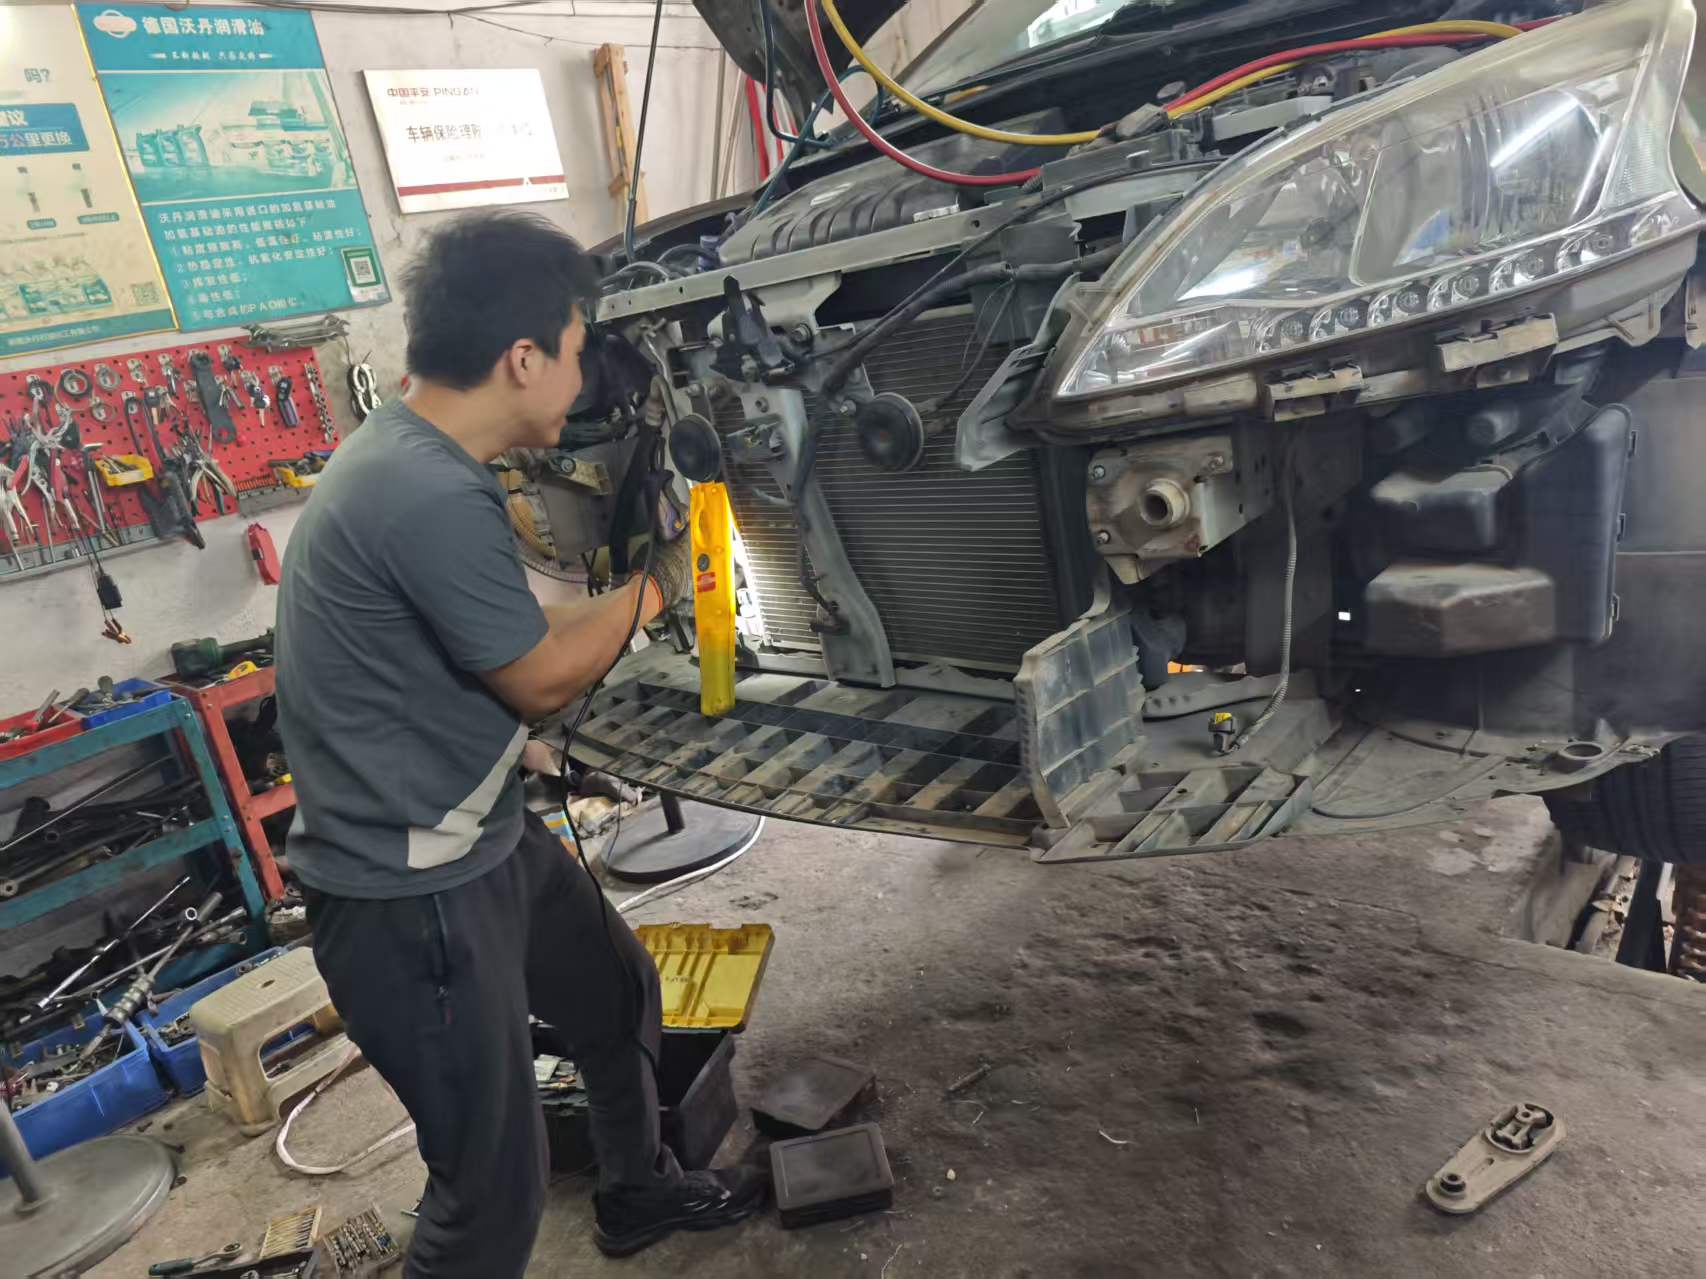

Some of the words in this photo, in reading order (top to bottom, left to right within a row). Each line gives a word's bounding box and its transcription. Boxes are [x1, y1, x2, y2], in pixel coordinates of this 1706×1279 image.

[142, 16, 265, 36] 德国沃丹润滑油
[387, 87, 431, 97] 中国平安
